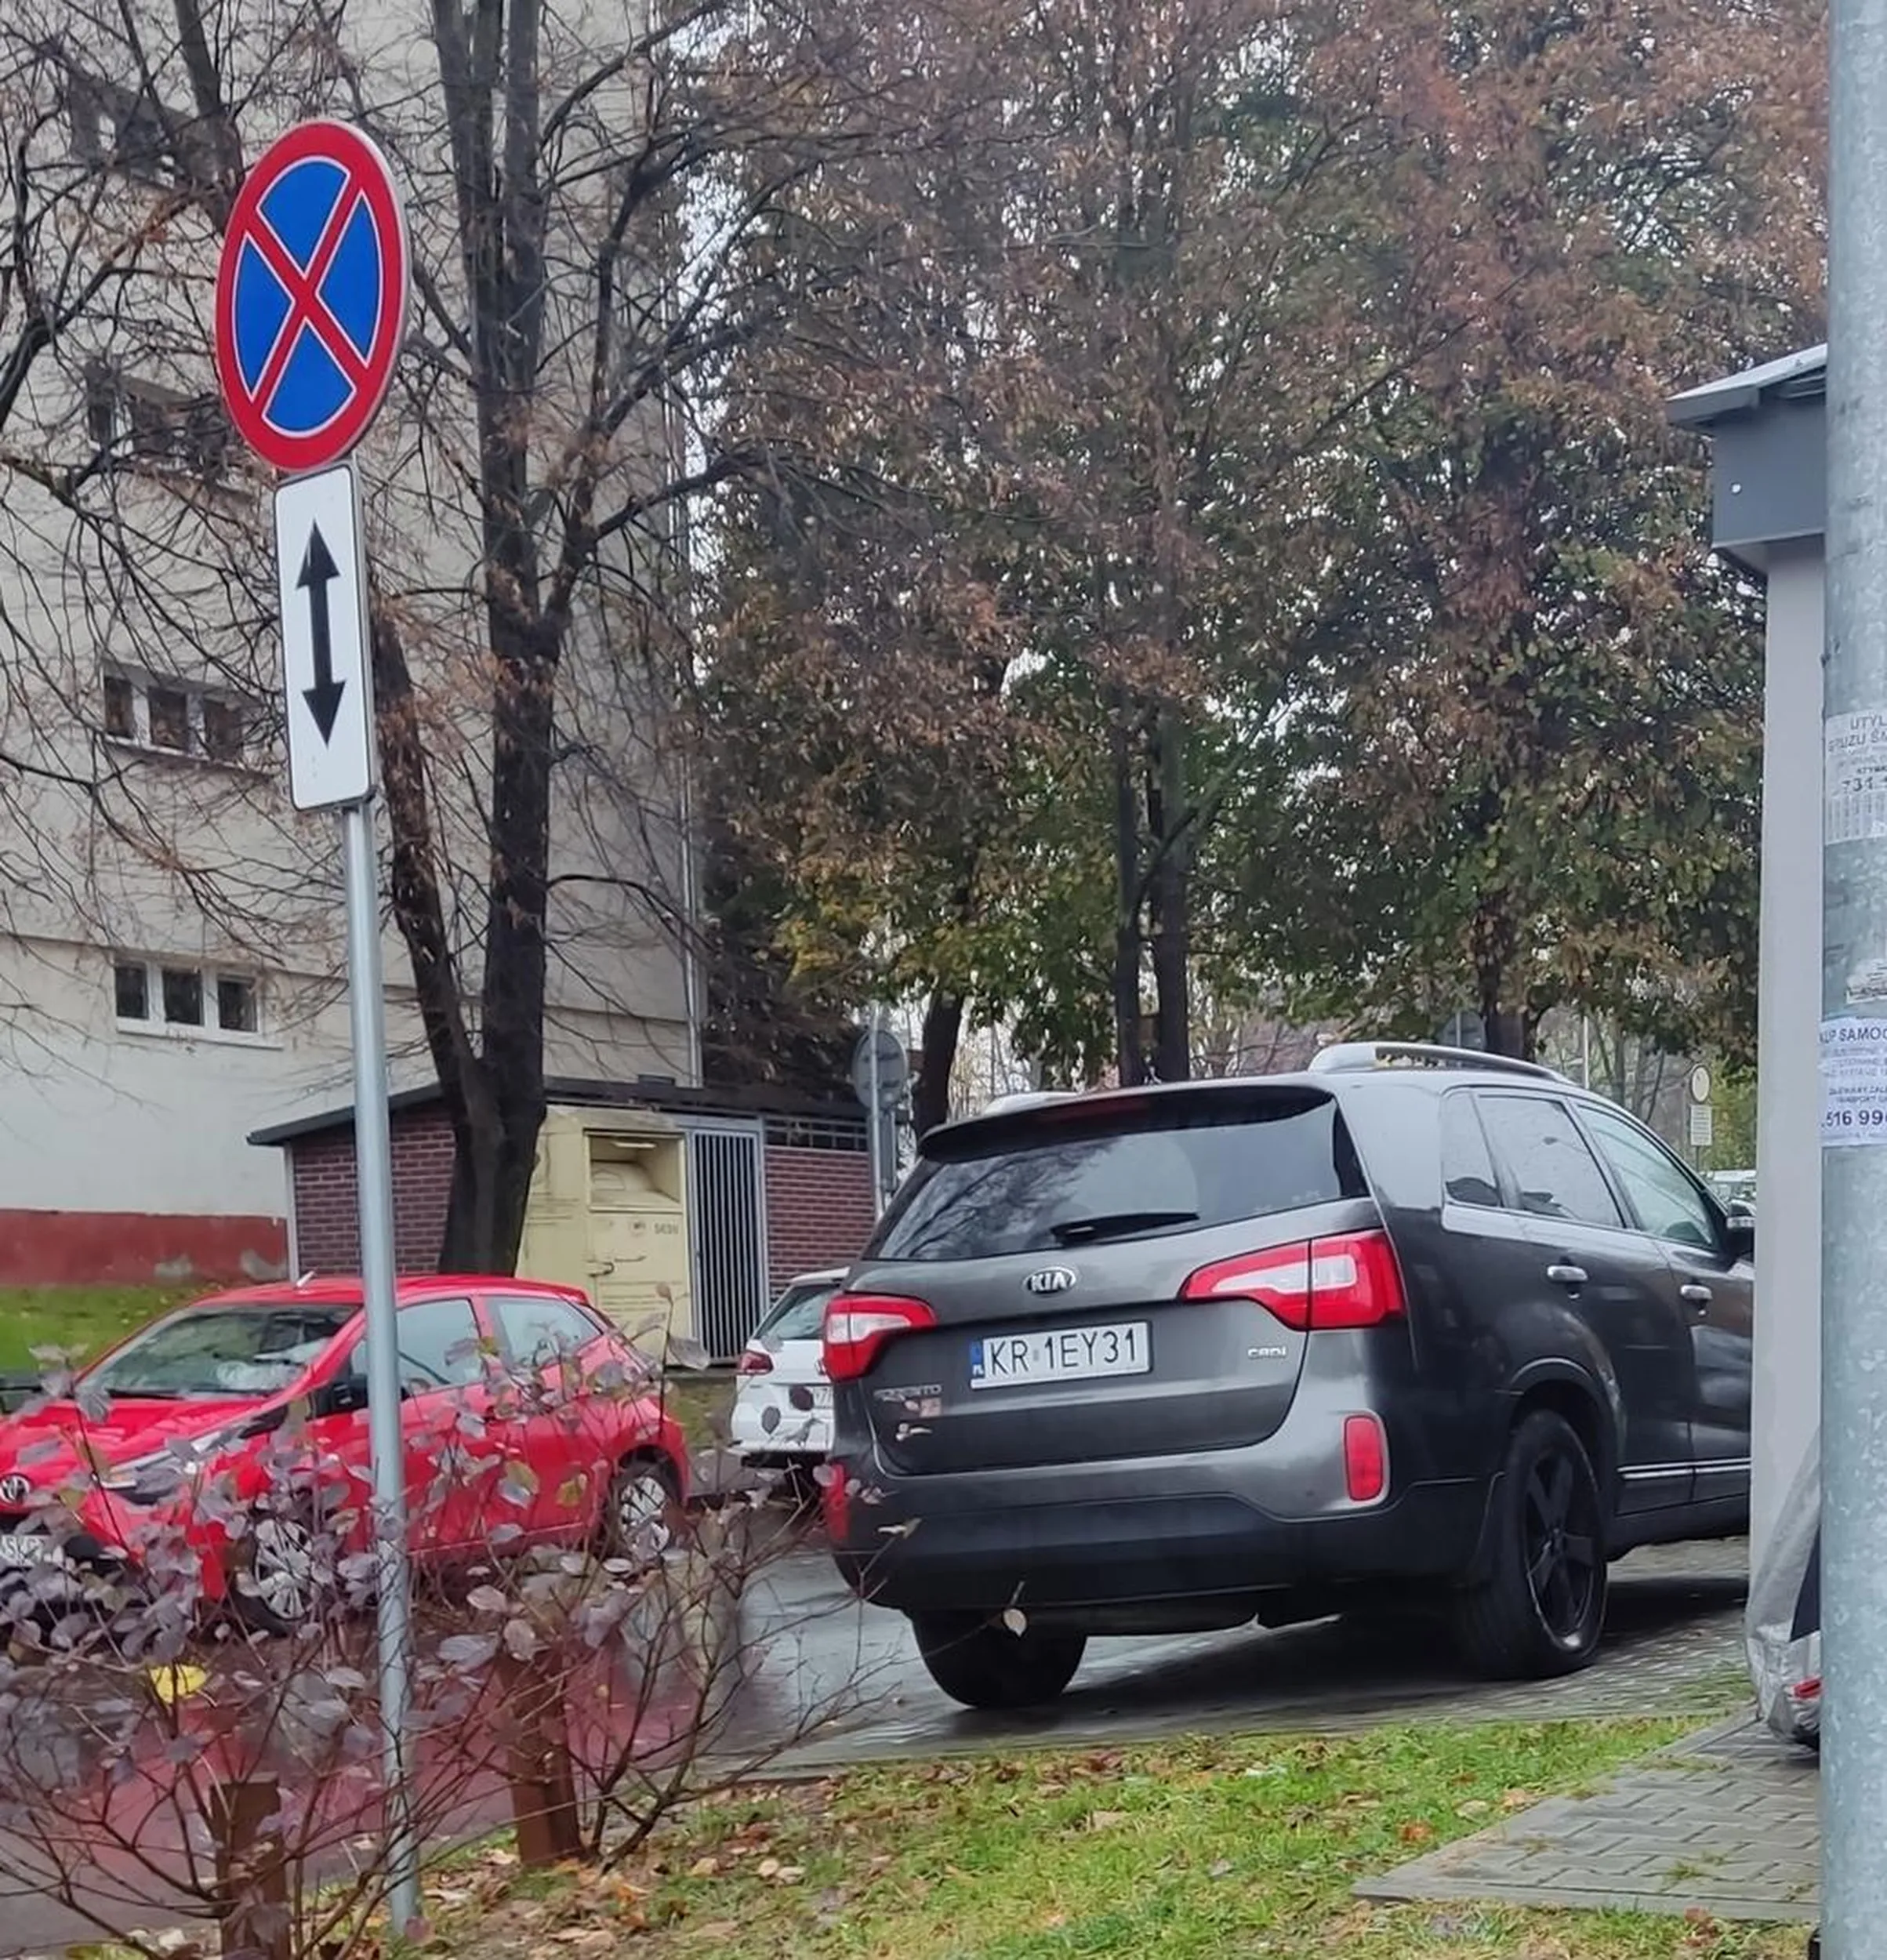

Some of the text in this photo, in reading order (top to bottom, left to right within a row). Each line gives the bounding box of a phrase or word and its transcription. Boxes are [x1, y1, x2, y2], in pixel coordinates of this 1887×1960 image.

[1858, 1109, 1887, 1126] 99
[1032, 1271, 1067, 1291] KIA
[990, 1328, 1135, 1375] KR 1EY31
